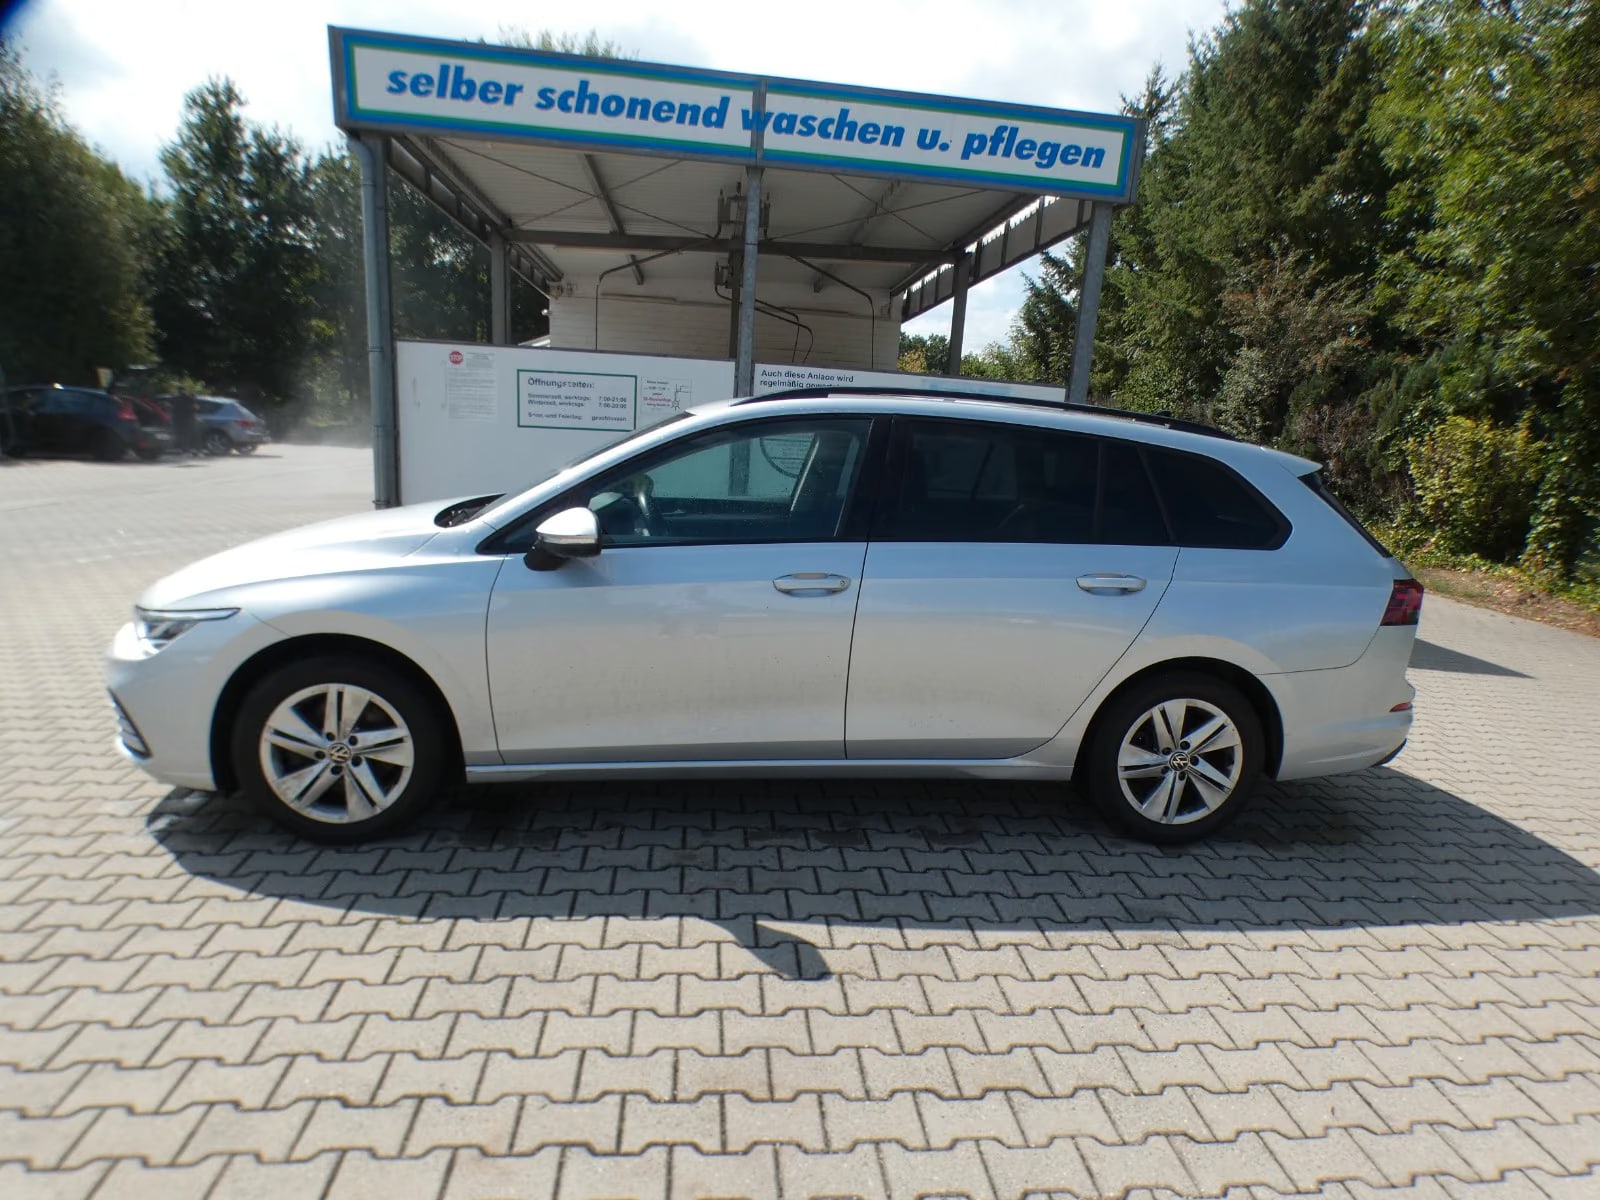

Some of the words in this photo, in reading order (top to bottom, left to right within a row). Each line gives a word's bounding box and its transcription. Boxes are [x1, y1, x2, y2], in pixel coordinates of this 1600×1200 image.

[386, 63, 524, 107] selber
[535, 79, 731, 130] schonend
[741, 107, 905, 148] waschen
[917, 128, 951, 152] u.
[961, 125, 1106, 169] pflegen
[527, 376, 595, 389] Öffnungszeiten:
[761, 369, 782, 378] Auch
[784, 371, 806, 379] diese
[807, 372, 835, 382] Anlage
[837, 375, 855, 383] wird
[759, 379, 804, 389] regelmäßig
